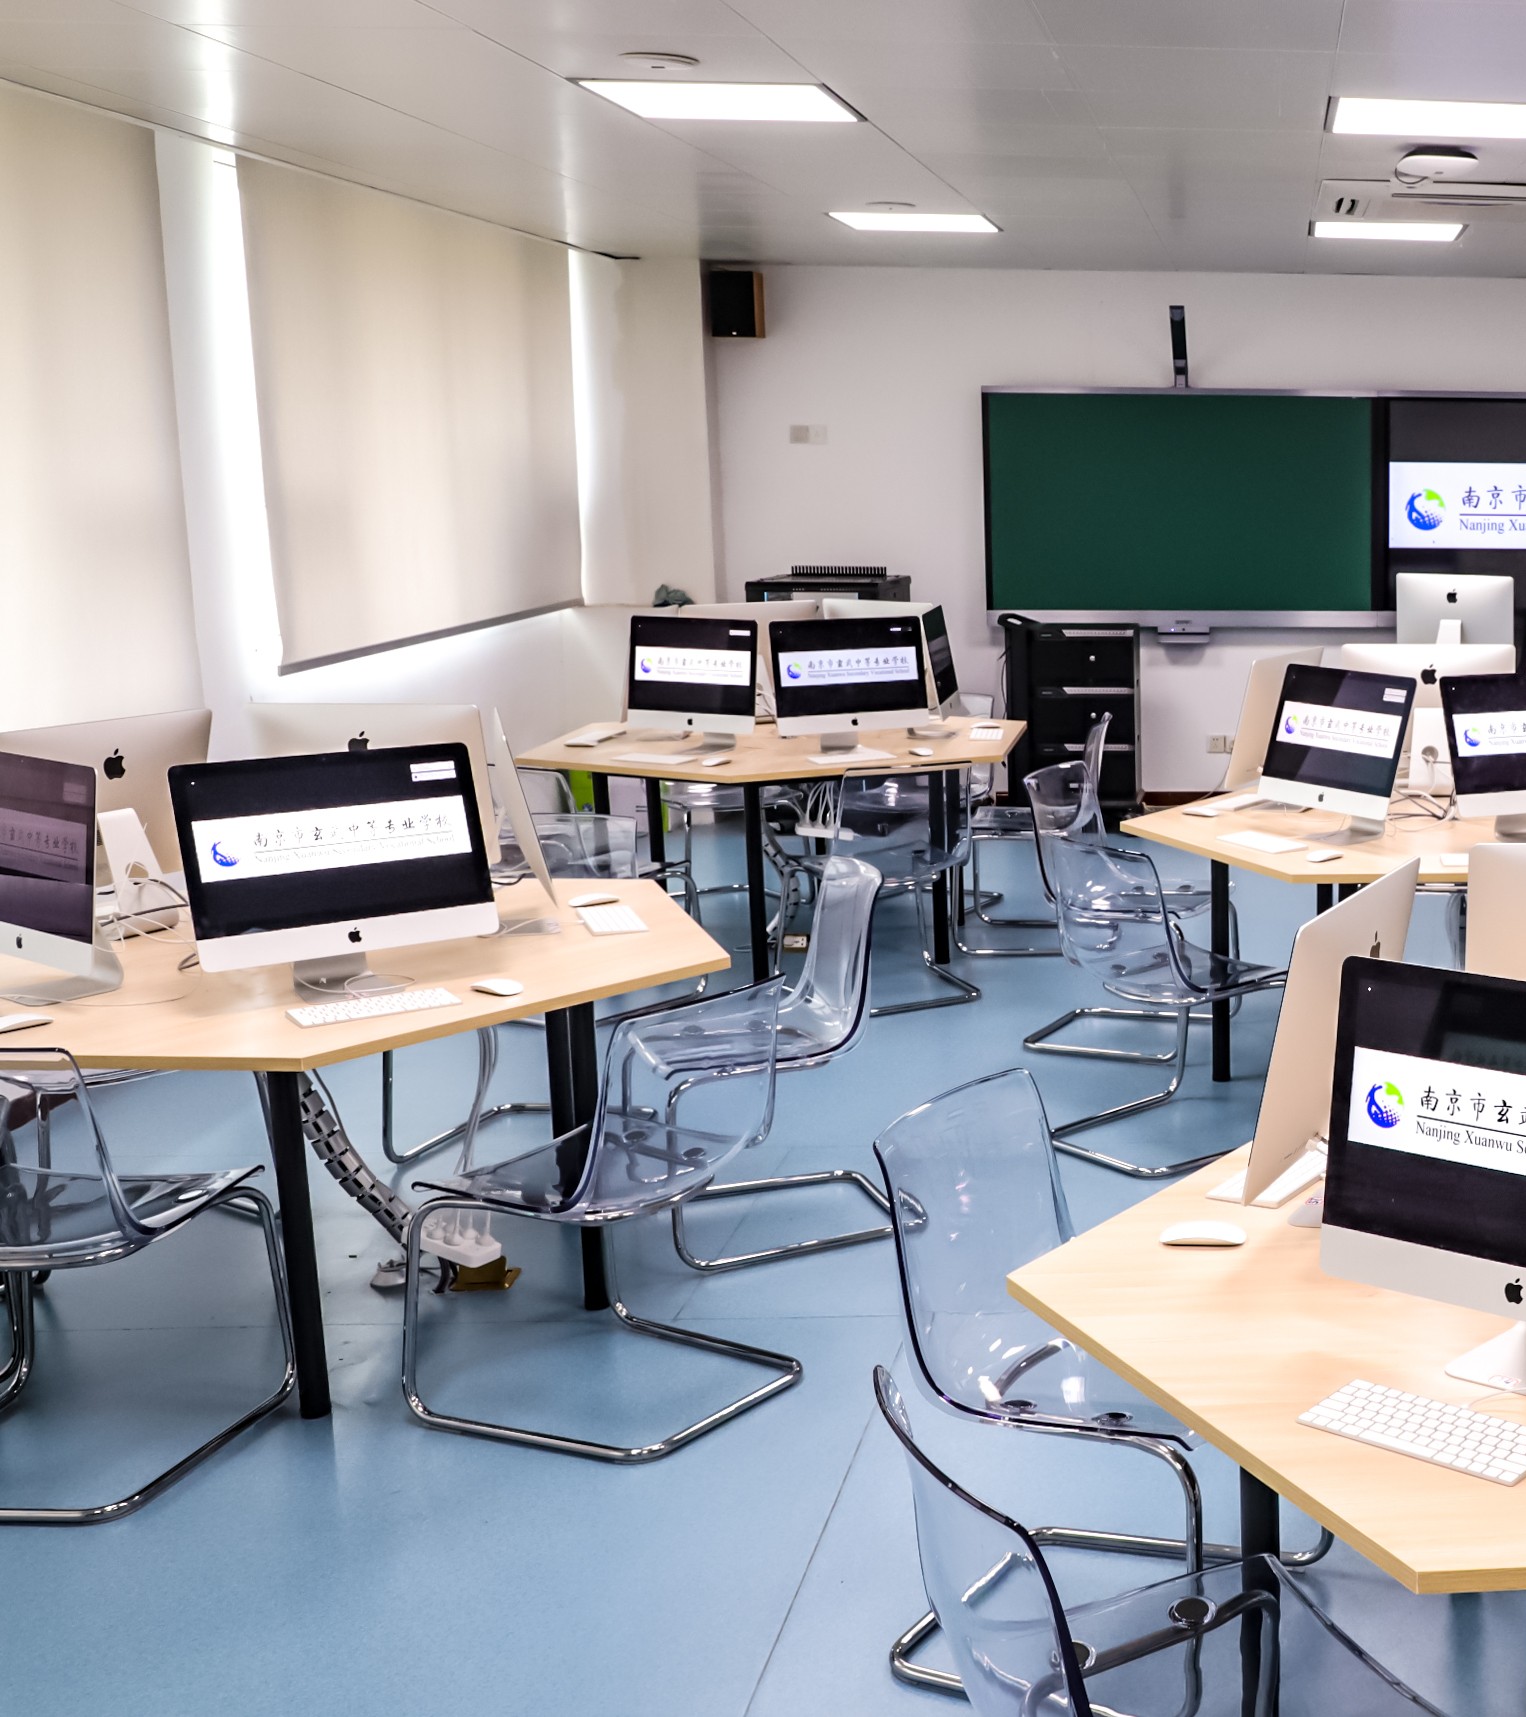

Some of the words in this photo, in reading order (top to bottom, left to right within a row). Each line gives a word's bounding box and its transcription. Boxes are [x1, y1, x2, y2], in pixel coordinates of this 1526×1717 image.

[1459, 518, 1505, 535] Nanjing
[1415, 1120, 1460, 1144] Nanjing
[1464, 1131, 1513, 1152] Xuanwu
